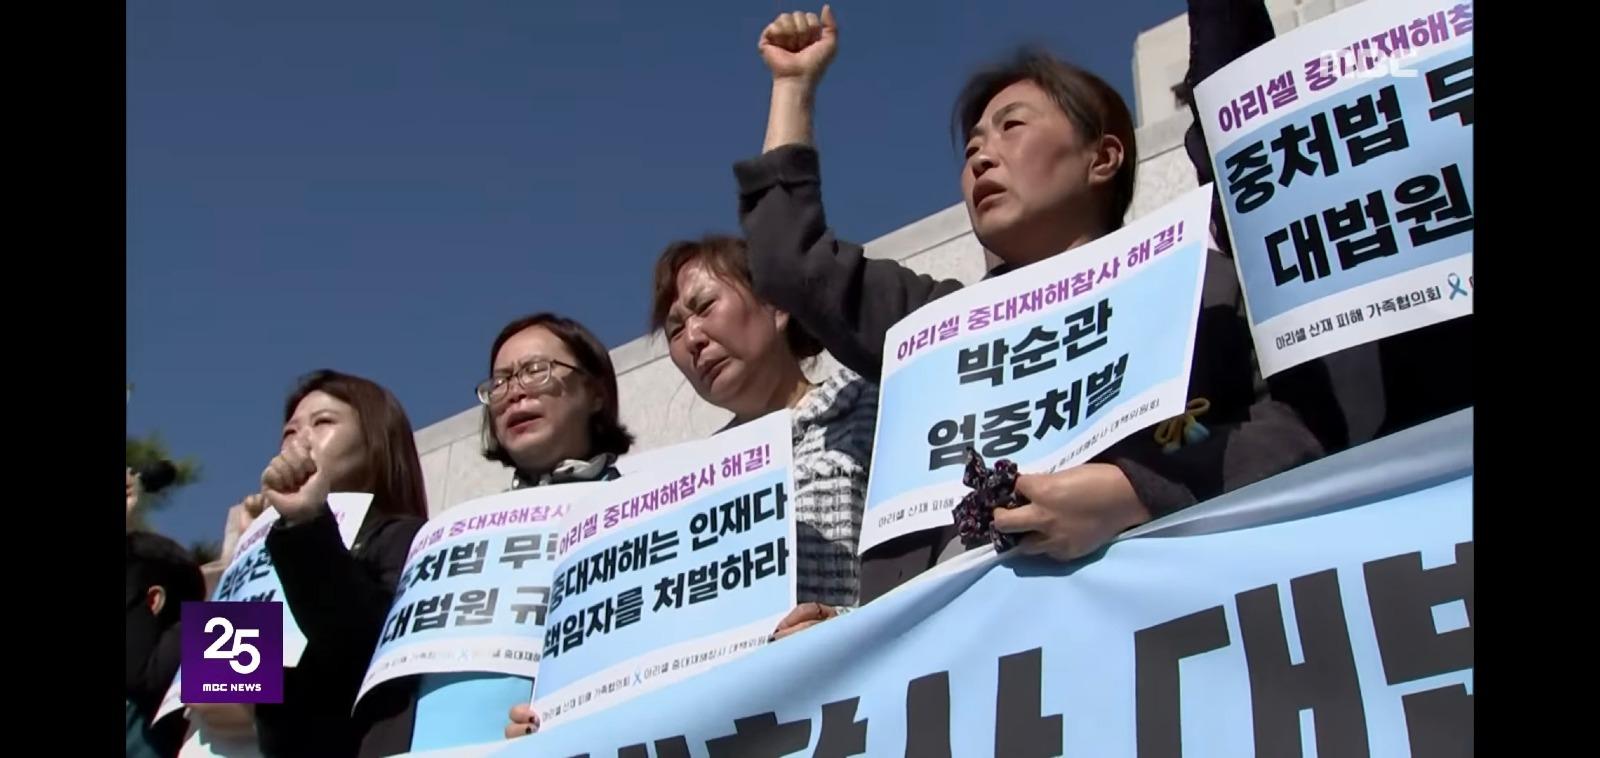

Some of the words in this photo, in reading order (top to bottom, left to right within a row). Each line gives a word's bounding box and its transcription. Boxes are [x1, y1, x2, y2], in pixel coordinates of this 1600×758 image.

[1218, 71, 1298, 132] 아리셀
[1225, 84, 1410, 214] 중처법
[1264, 163, 1473, 287] 대법원
[897, 315, 960, 361] 아리셀
[967, 258, 1120, 331] 중대재해참사
[1126, 220, 1185, 268] 해결!
[956, 298, 1113, 387] 박순관
[1276, 327, 1307, 350] 아리셀
[1309, 318, 1333, 338] 산재
[1336, 310, 1364, 328] 피해
[1368, 286, 1441, 319] 가족협의회
[927, 353, 1129, 471] 엄중처벌
[549, 529, 680, 613] 중대재해는
[689, 482, 788, 551] 인재다
[558, 513, 598, 555] 아리셀
[603, 464, 715, 528] 중대재해참사
[721, 444, 771, 478] 해결!
[380, 588, 499, 648] 대법원
[542, 586, 644, 658] 책임자를
[652, 537, 789, 613] 처벌하라
